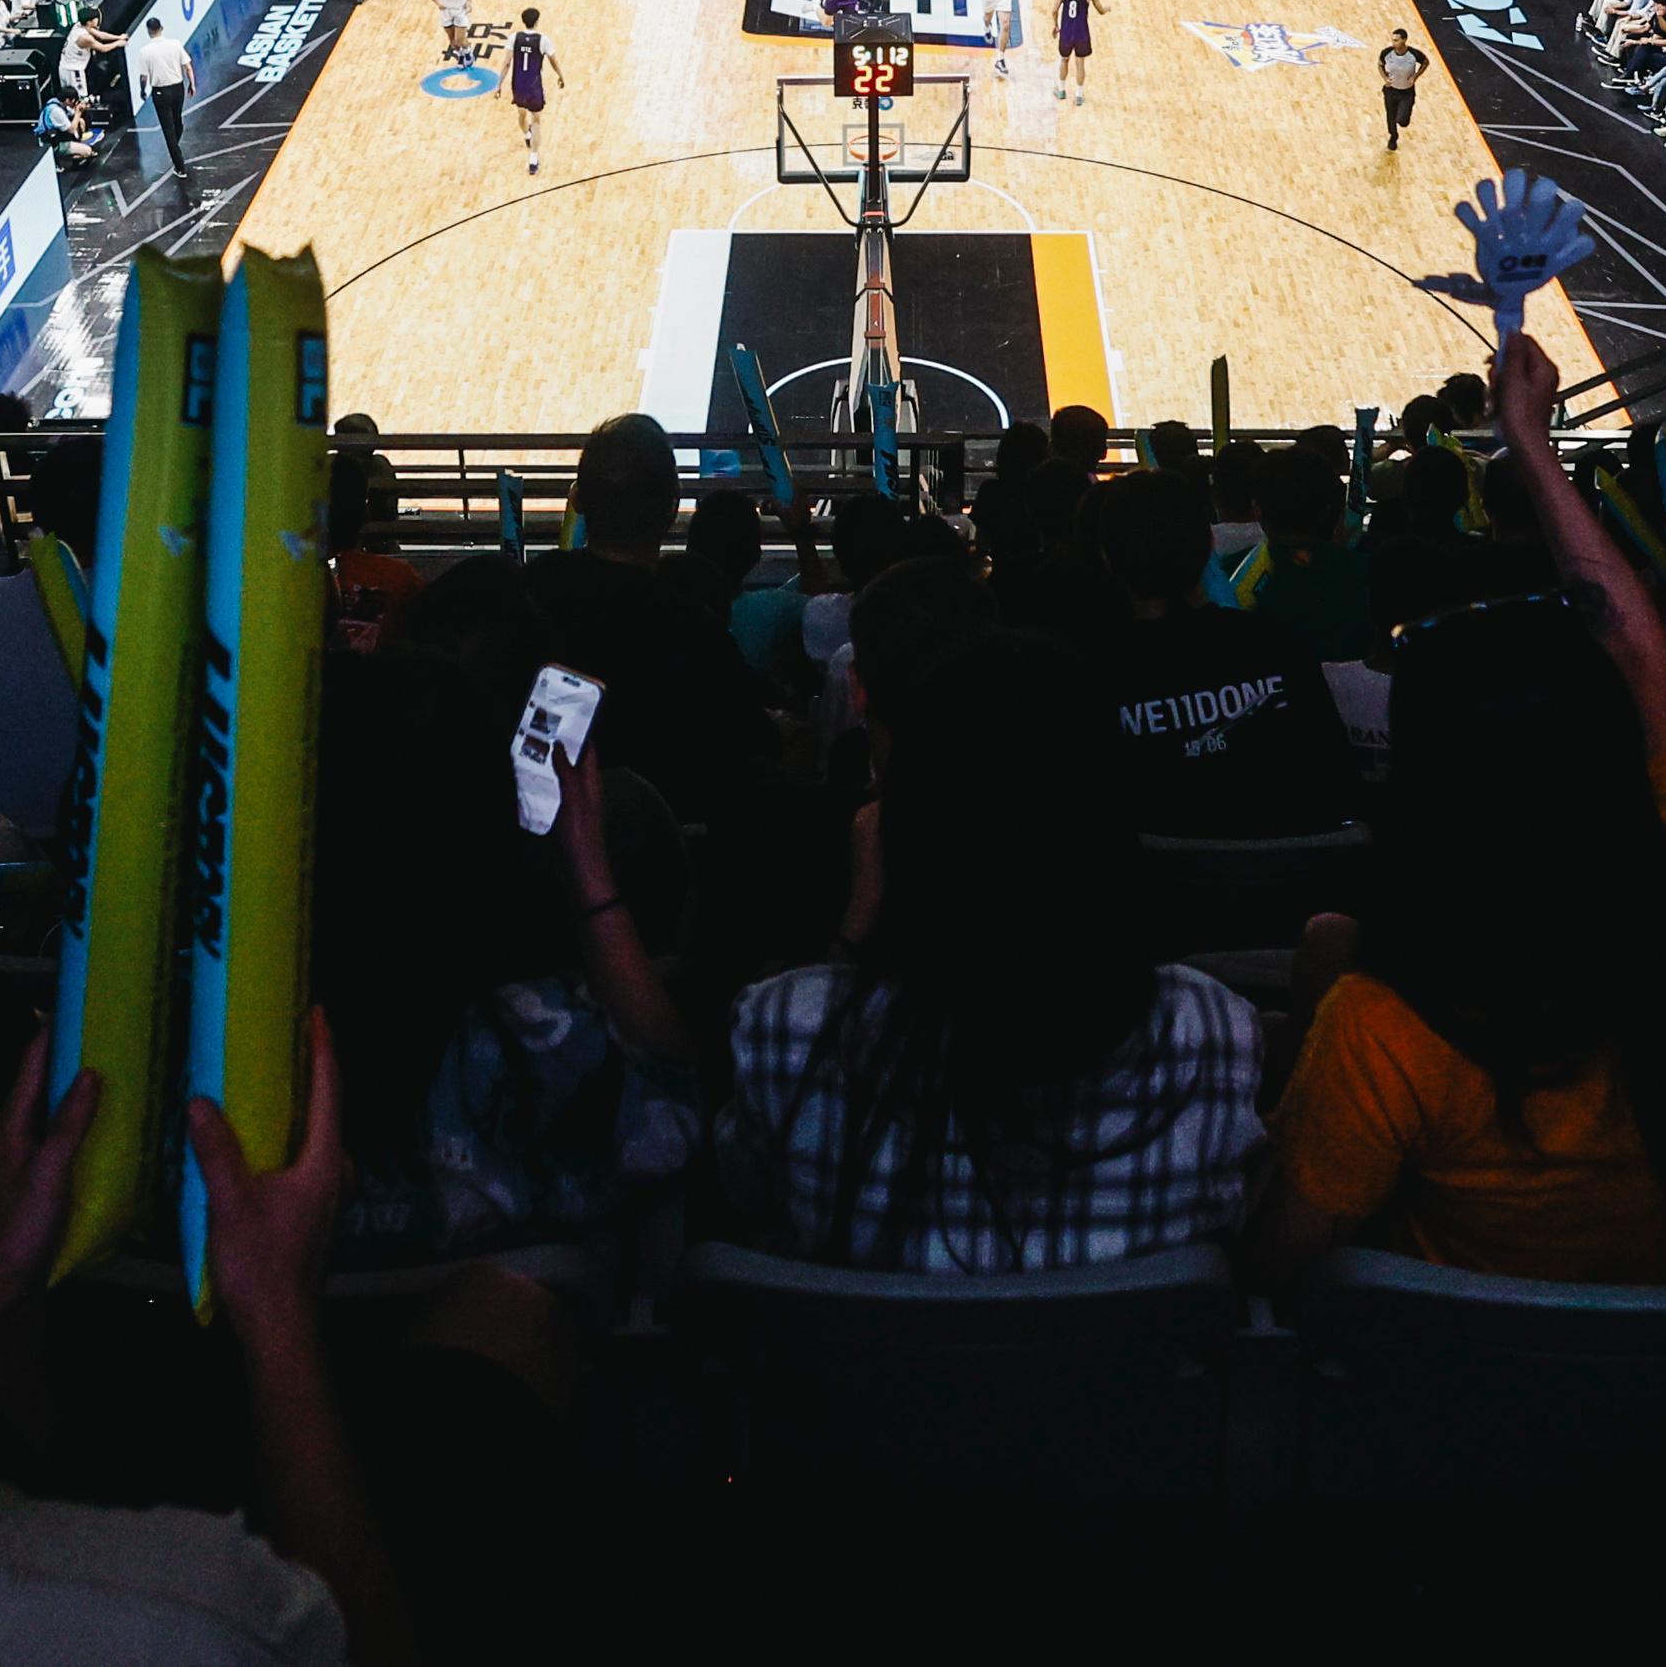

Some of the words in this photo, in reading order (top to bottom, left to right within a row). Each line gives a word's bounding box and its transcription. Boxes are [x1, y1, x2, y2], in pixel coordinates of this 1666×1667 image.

[1069, 1, 1077, 19] 8
[237, 5, 296, 69] ASIAN
[854, 65, 894, 93] 22
